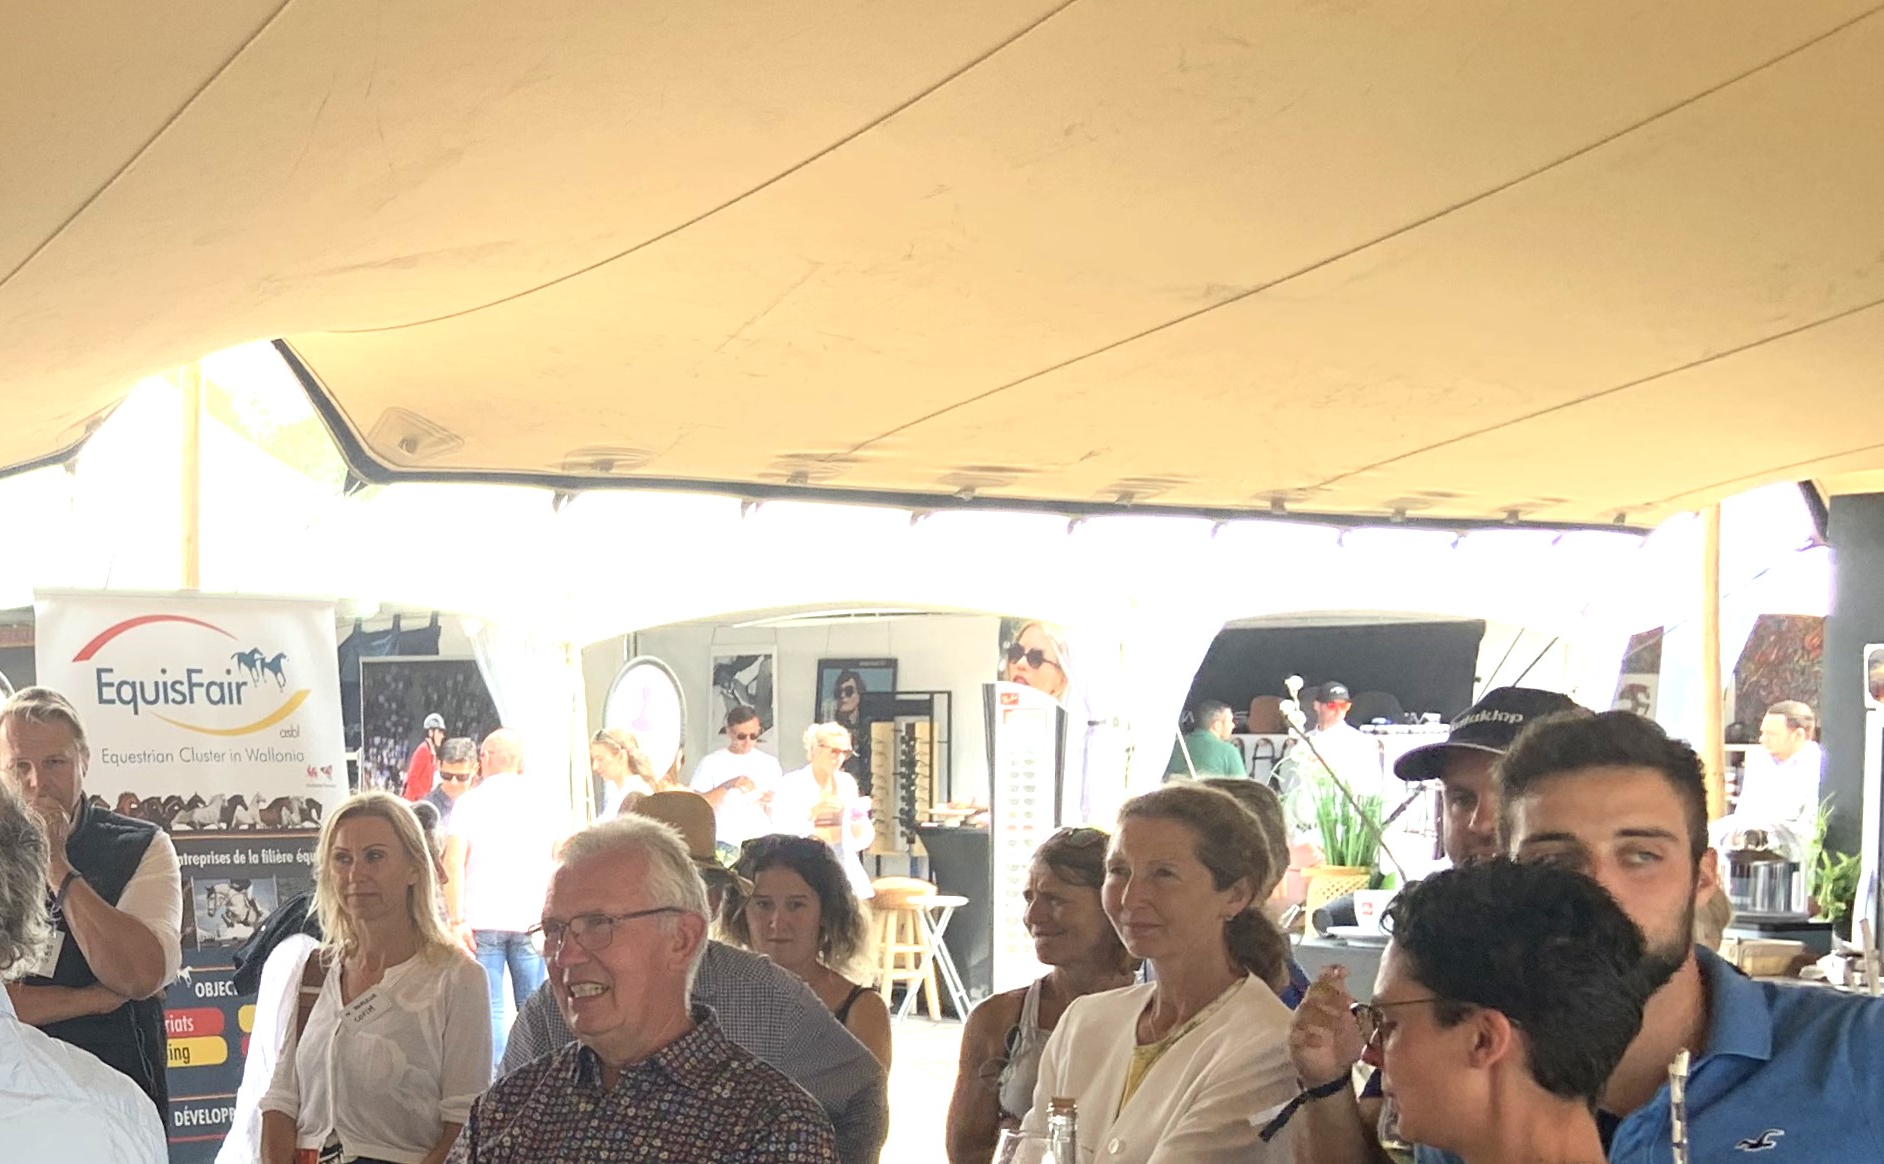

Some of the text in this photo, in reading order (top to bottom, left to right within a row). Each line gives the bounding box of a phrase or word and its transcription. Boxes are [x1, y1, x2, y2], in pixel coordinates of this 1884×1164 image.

[96, 667, 248, 715] EquisFair
[279, 723, 301, 738] asbl
[101, 747, 304, 767] Equestrian Cluster in Wallonia
[233, 849, 246, 864] de
[248, 849, 259, 864] la
[261, 848, 294, 864] filière
[167, 1043, 190, 1064] ing
